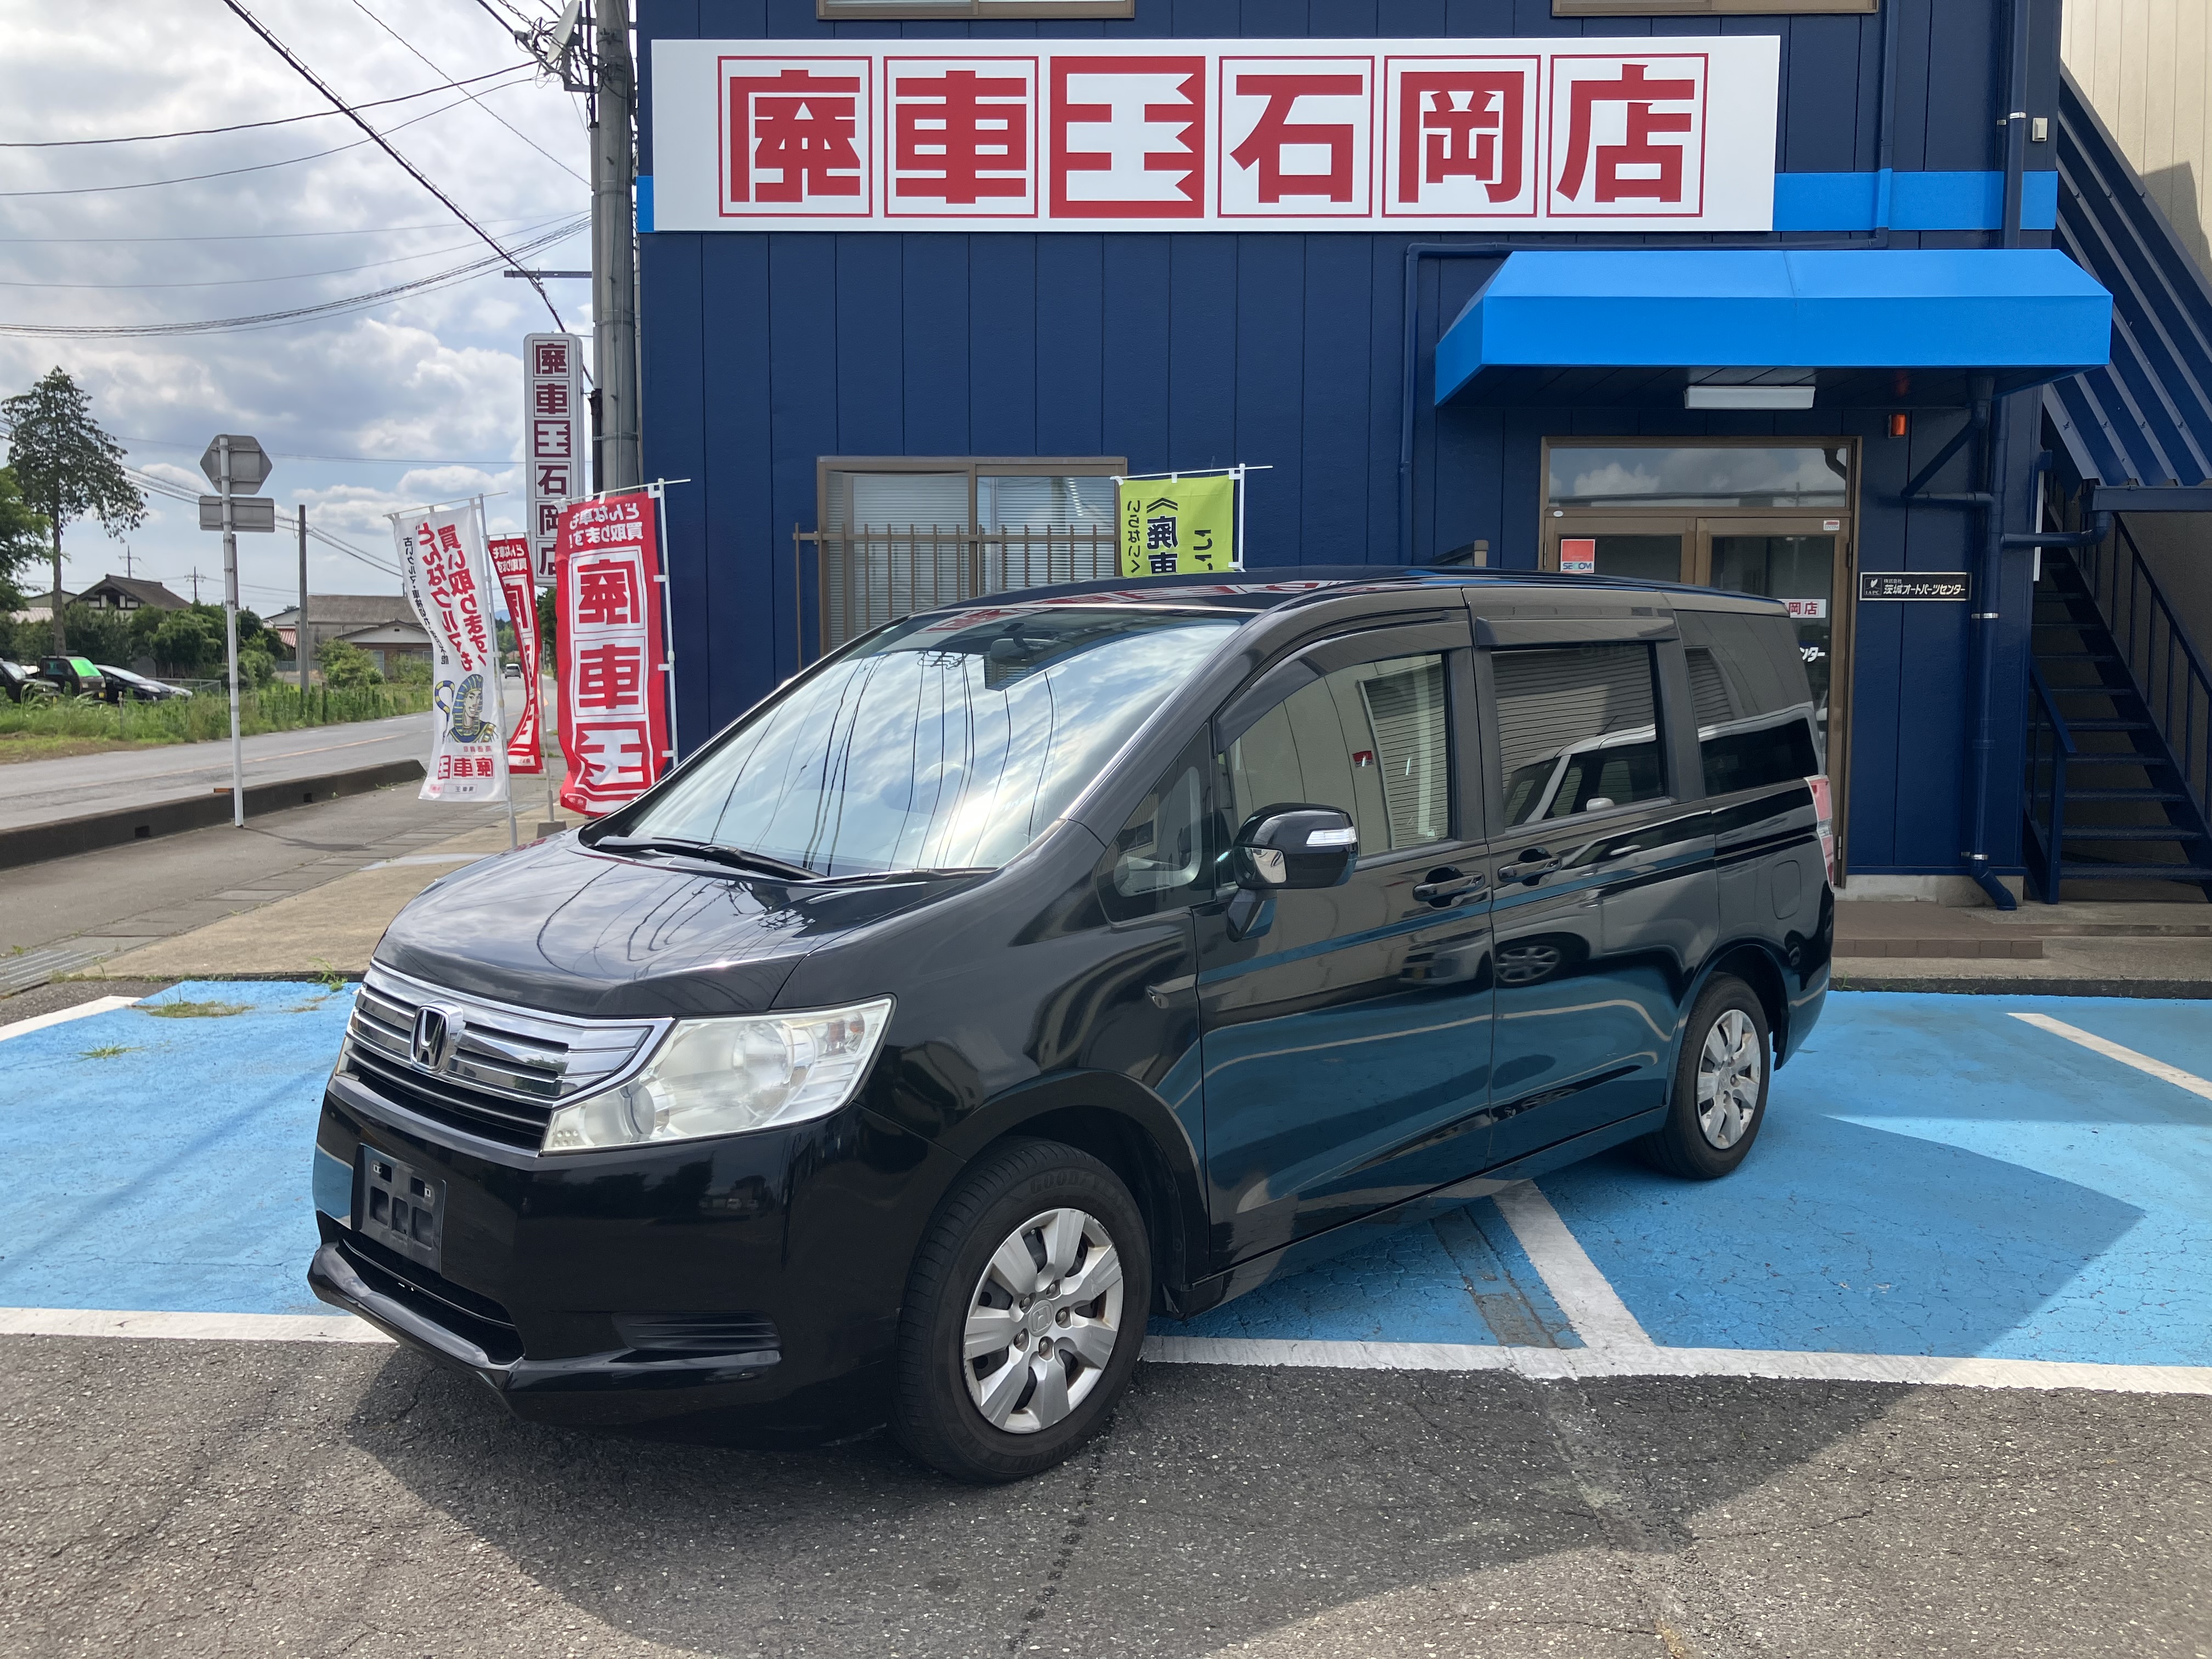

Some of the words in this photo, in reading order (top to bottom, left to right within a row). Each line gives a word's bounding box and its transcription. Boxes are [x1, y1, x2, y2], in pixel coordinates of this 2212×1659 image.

[730, 64, 1695, 204] 廃車王石岡店
[1883, 584, 1966, 595] 茨城オートパーツセンター
